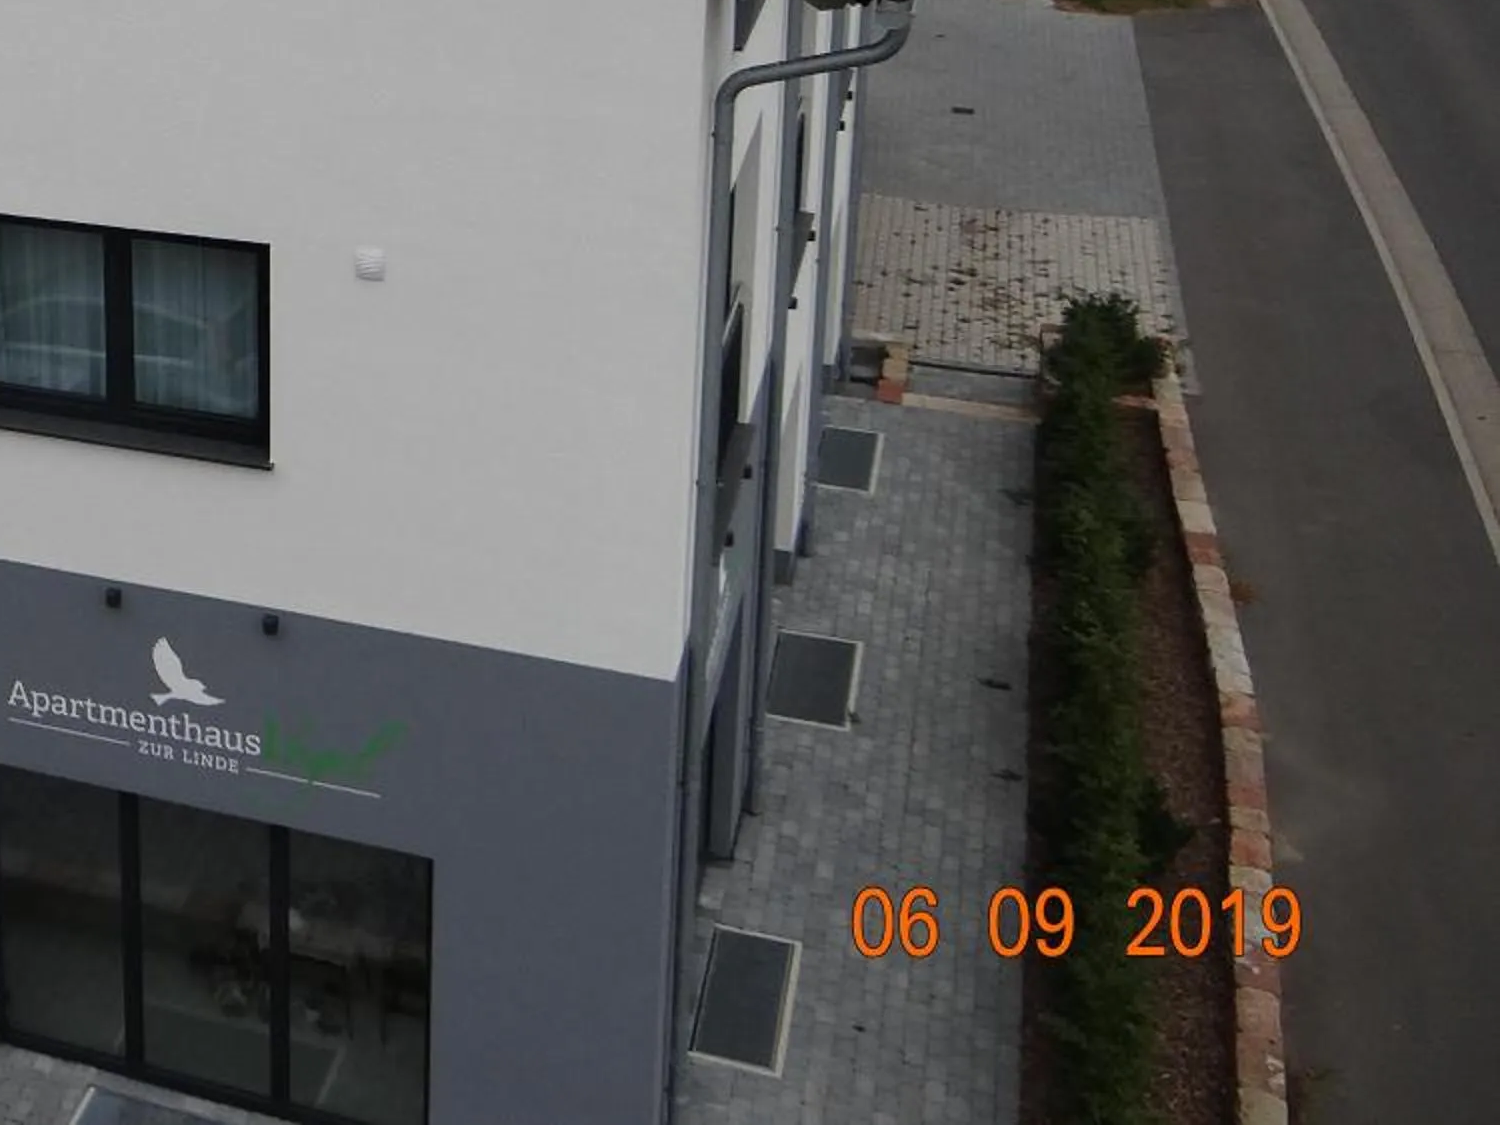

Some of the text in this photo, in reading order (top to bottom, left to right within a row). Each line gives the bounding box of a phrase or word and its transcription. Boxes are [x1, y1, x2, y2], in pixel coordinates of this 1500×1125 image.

[7, 679, 262, 756] Apartmenthaus
[137, 739, 240, 775] ZUR LINDE
